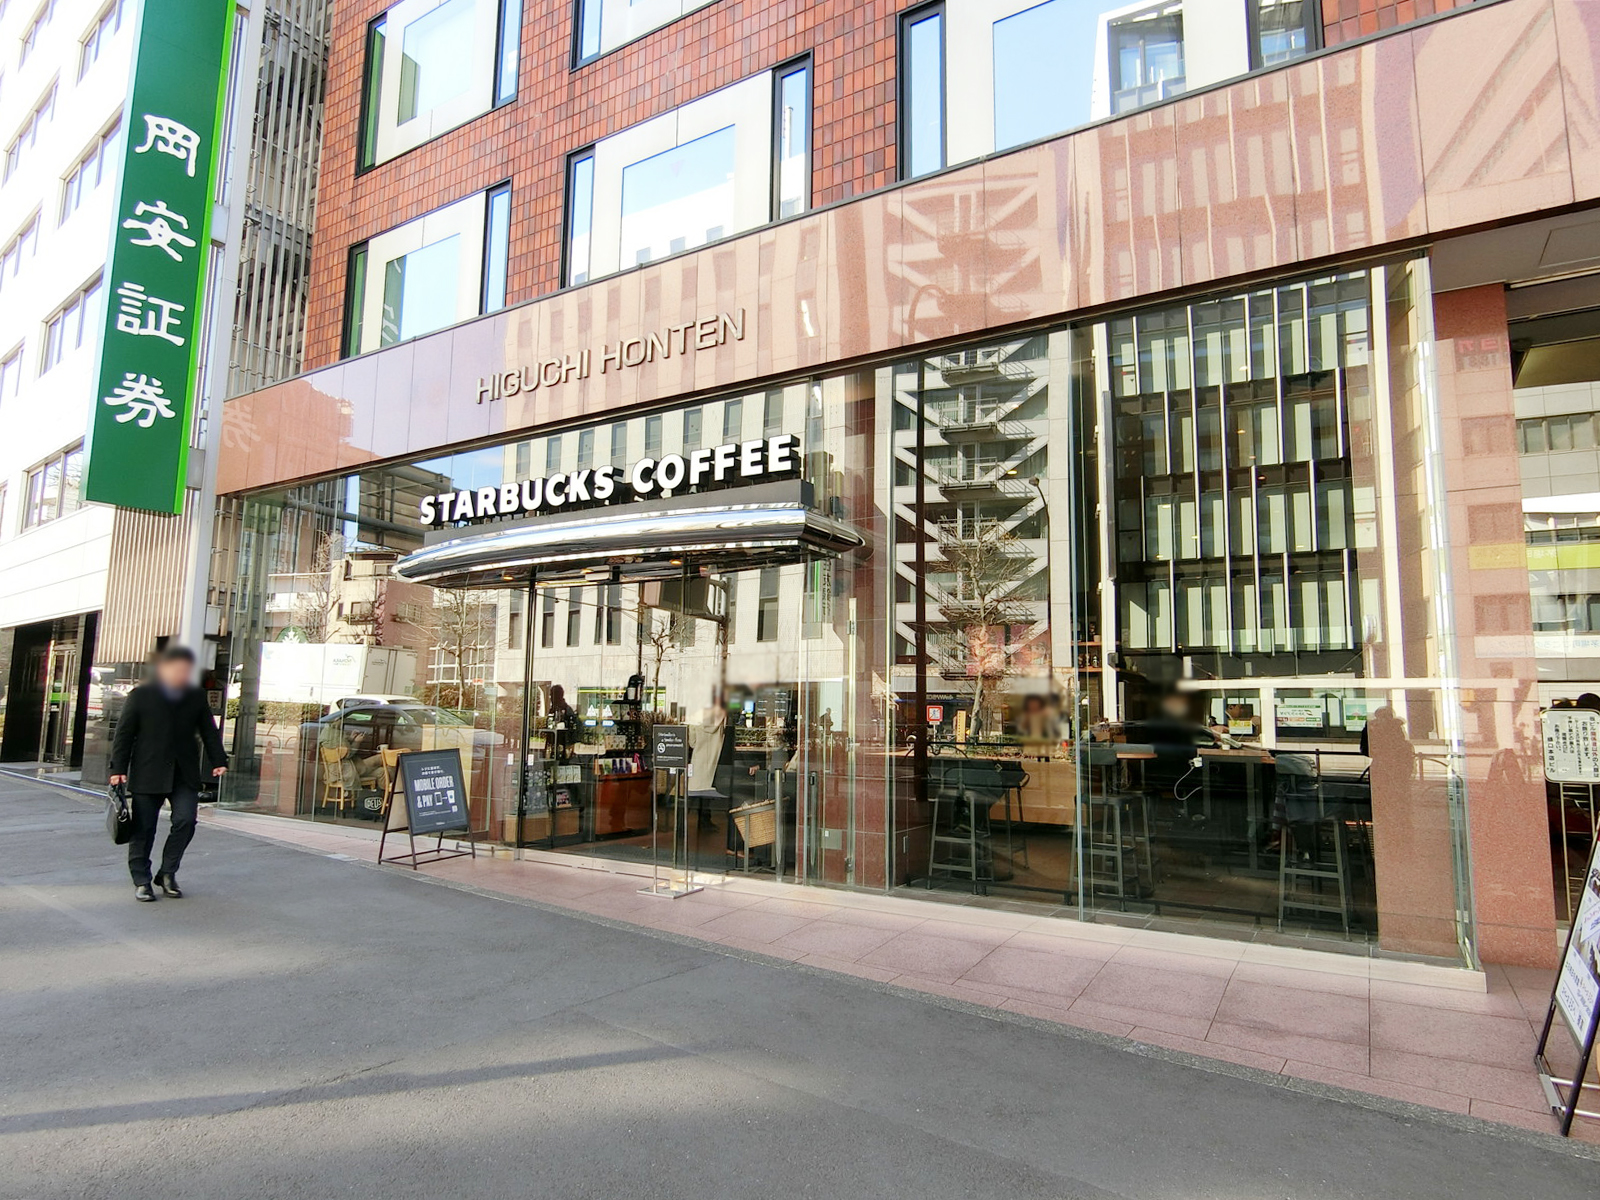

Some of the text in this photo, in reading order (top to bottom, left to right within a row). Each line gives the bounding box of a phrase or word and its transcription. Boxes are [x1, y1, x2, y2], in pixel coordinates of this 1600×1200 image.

[104, 113, 201, 428] 岡安証券
[475, 308, 746, 405] HIGUCHI HONTEN
[419, 434, 799, 526] STARBUCKS COFFEE
[414, 776, 454, 792] MOBILE ORDER
[416, 794, 433, 808] & PAY
